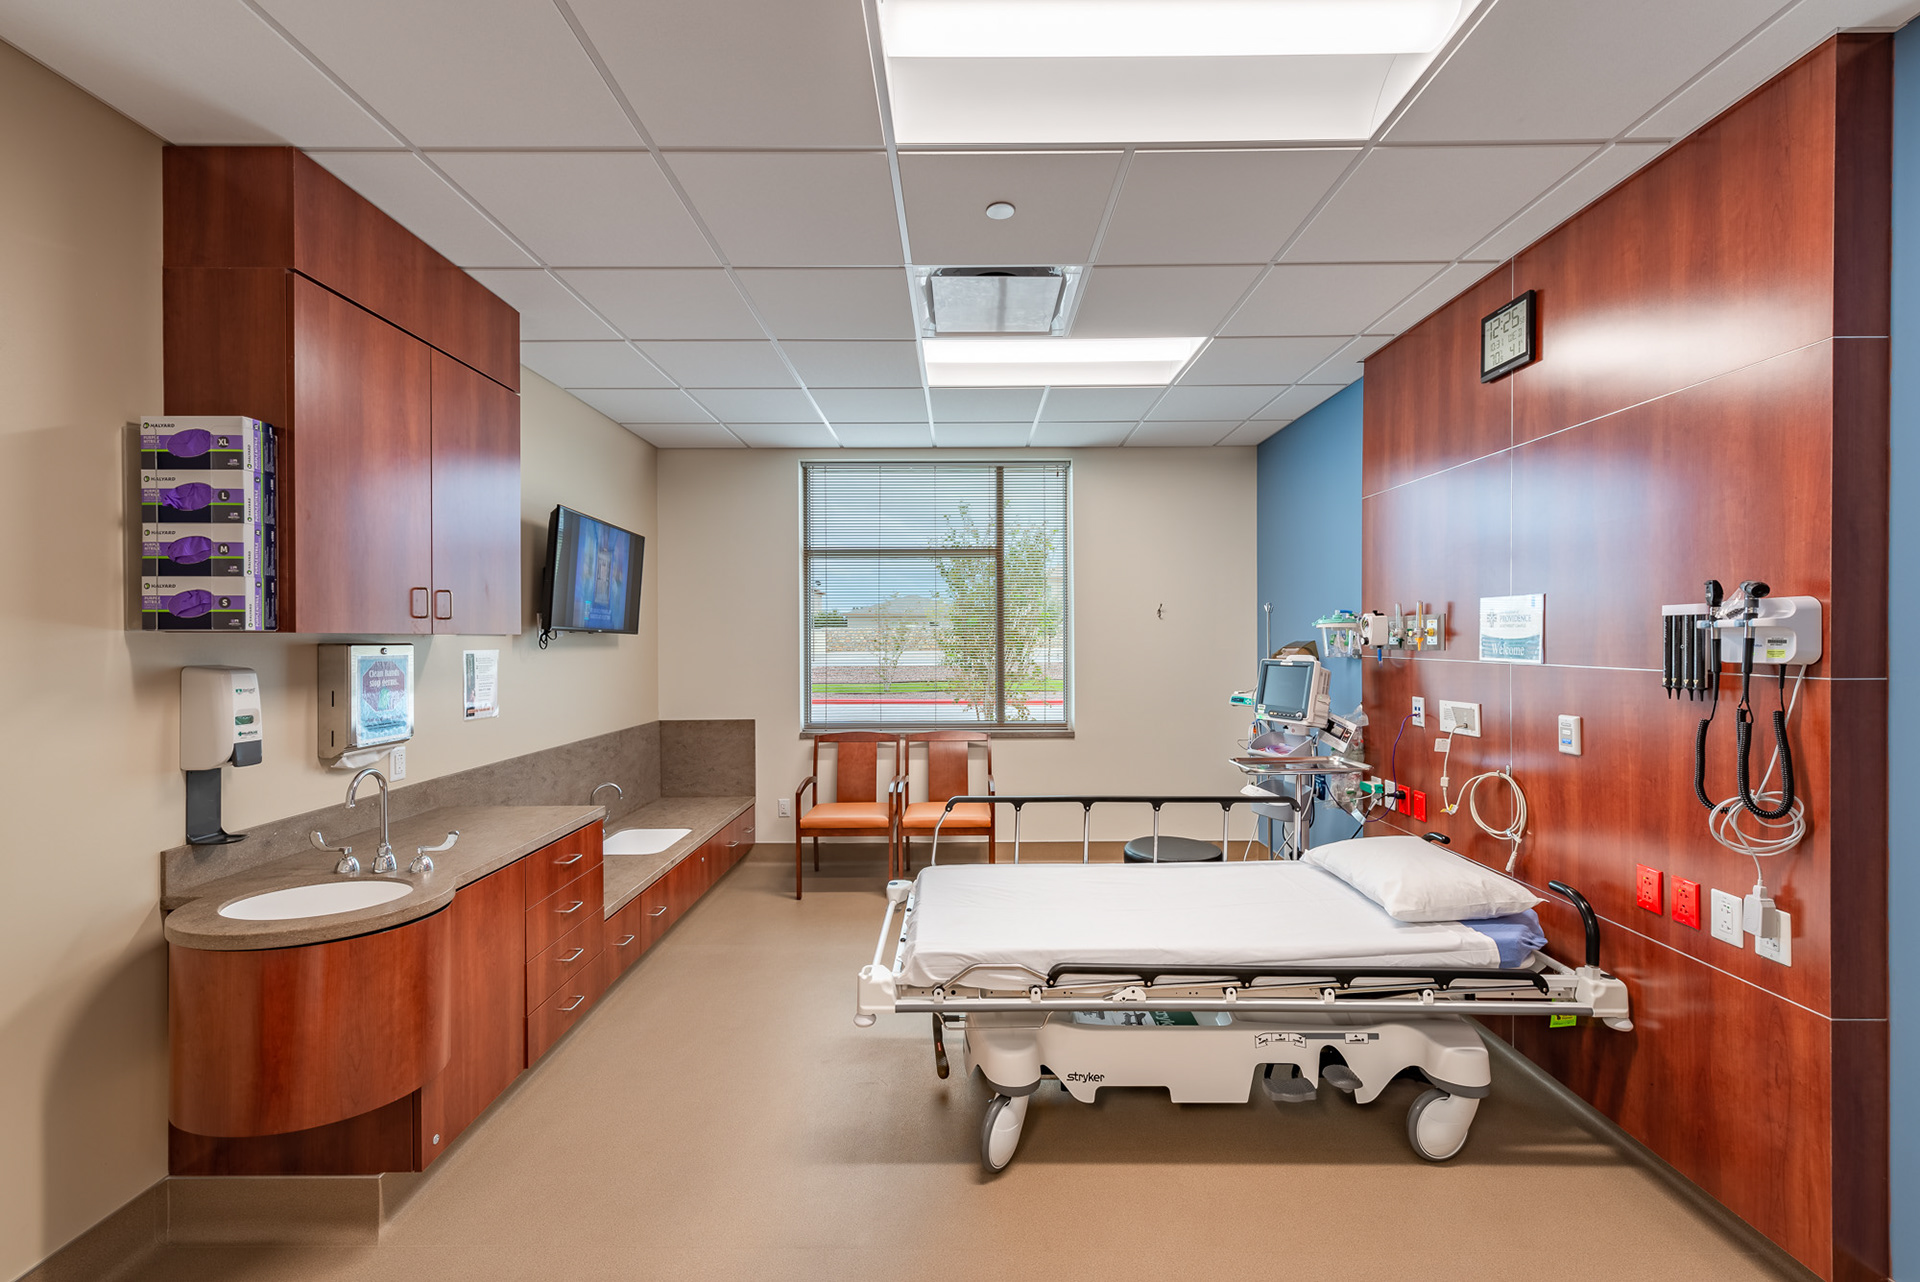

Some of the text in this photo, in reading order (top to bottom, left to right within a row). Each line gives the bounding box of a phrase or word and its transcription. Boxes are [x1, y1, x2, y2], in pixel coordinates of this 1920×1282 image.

[218, 438, 229, 446] XL
[220, 545, 228, 553] M
[222, 598, 228, 607] S
[1492, 642, 1525, 656] Welcome
[369, 679, 381, 687] stop
[1066, 1071, 1105, 1083] stryker
